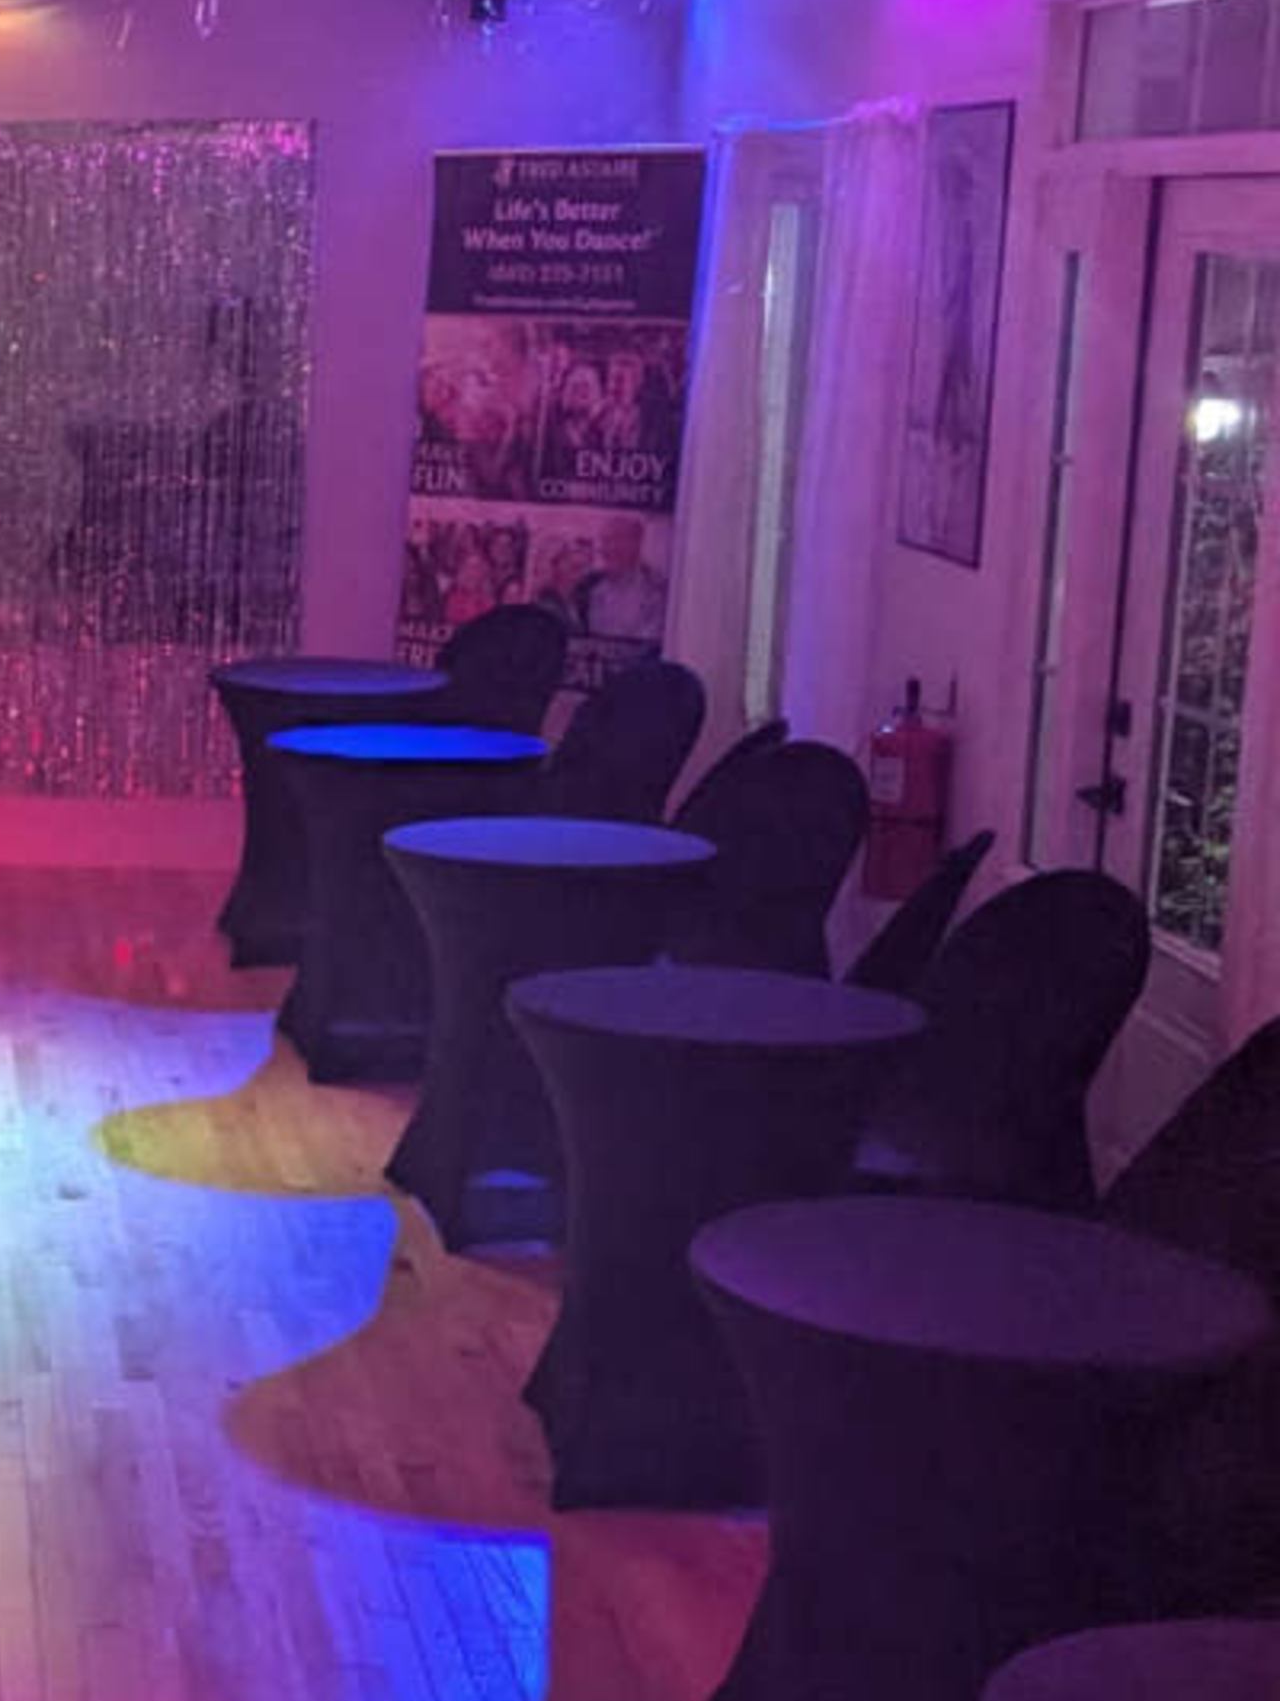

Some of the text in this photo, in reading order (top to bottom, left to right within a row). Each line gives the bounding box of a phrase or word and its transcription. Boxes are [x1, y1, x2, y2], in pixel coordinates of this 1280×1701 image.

[493, 198, 623, 222] Life's Better
[462, 227, 525, 251] When
[530, 227, 570, 251] You
[413, 464, 466, 492] FUN
[574, 449, 668, 482] ENJOY
